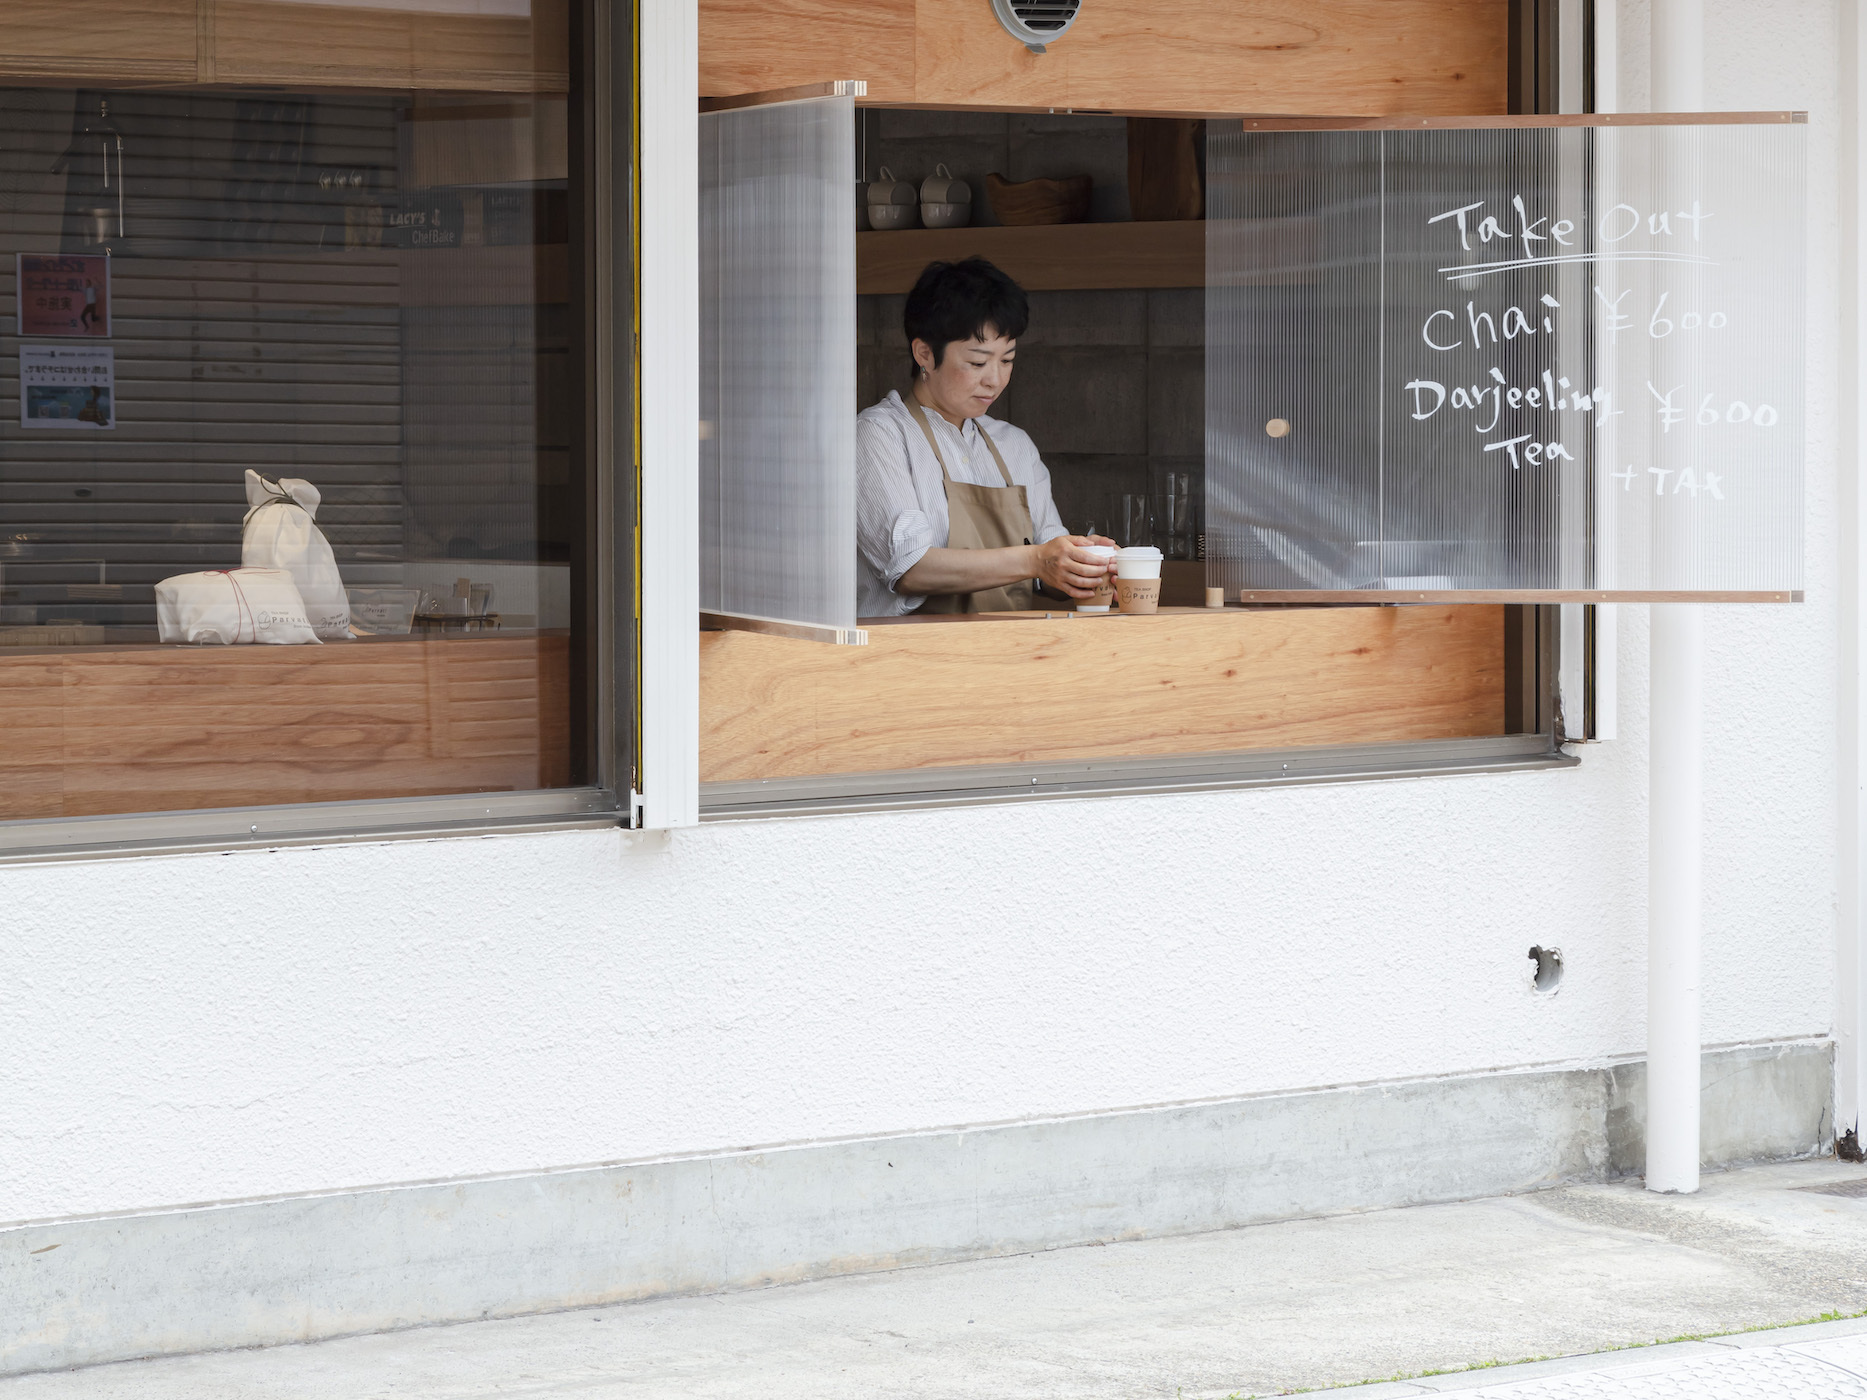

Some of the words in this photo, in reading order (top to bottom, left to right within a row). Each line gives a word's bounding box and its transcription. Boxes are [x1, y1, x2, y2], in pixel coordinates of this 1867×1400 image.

[1428, 194, 1574, 258] Take
[1600, 200, 1715, 242] Out
[1423, 293, 1560, 350] Chai
[1404, 367, 1623, 433] Darjeeling
[1483, 433, 1575, 469] Tea
